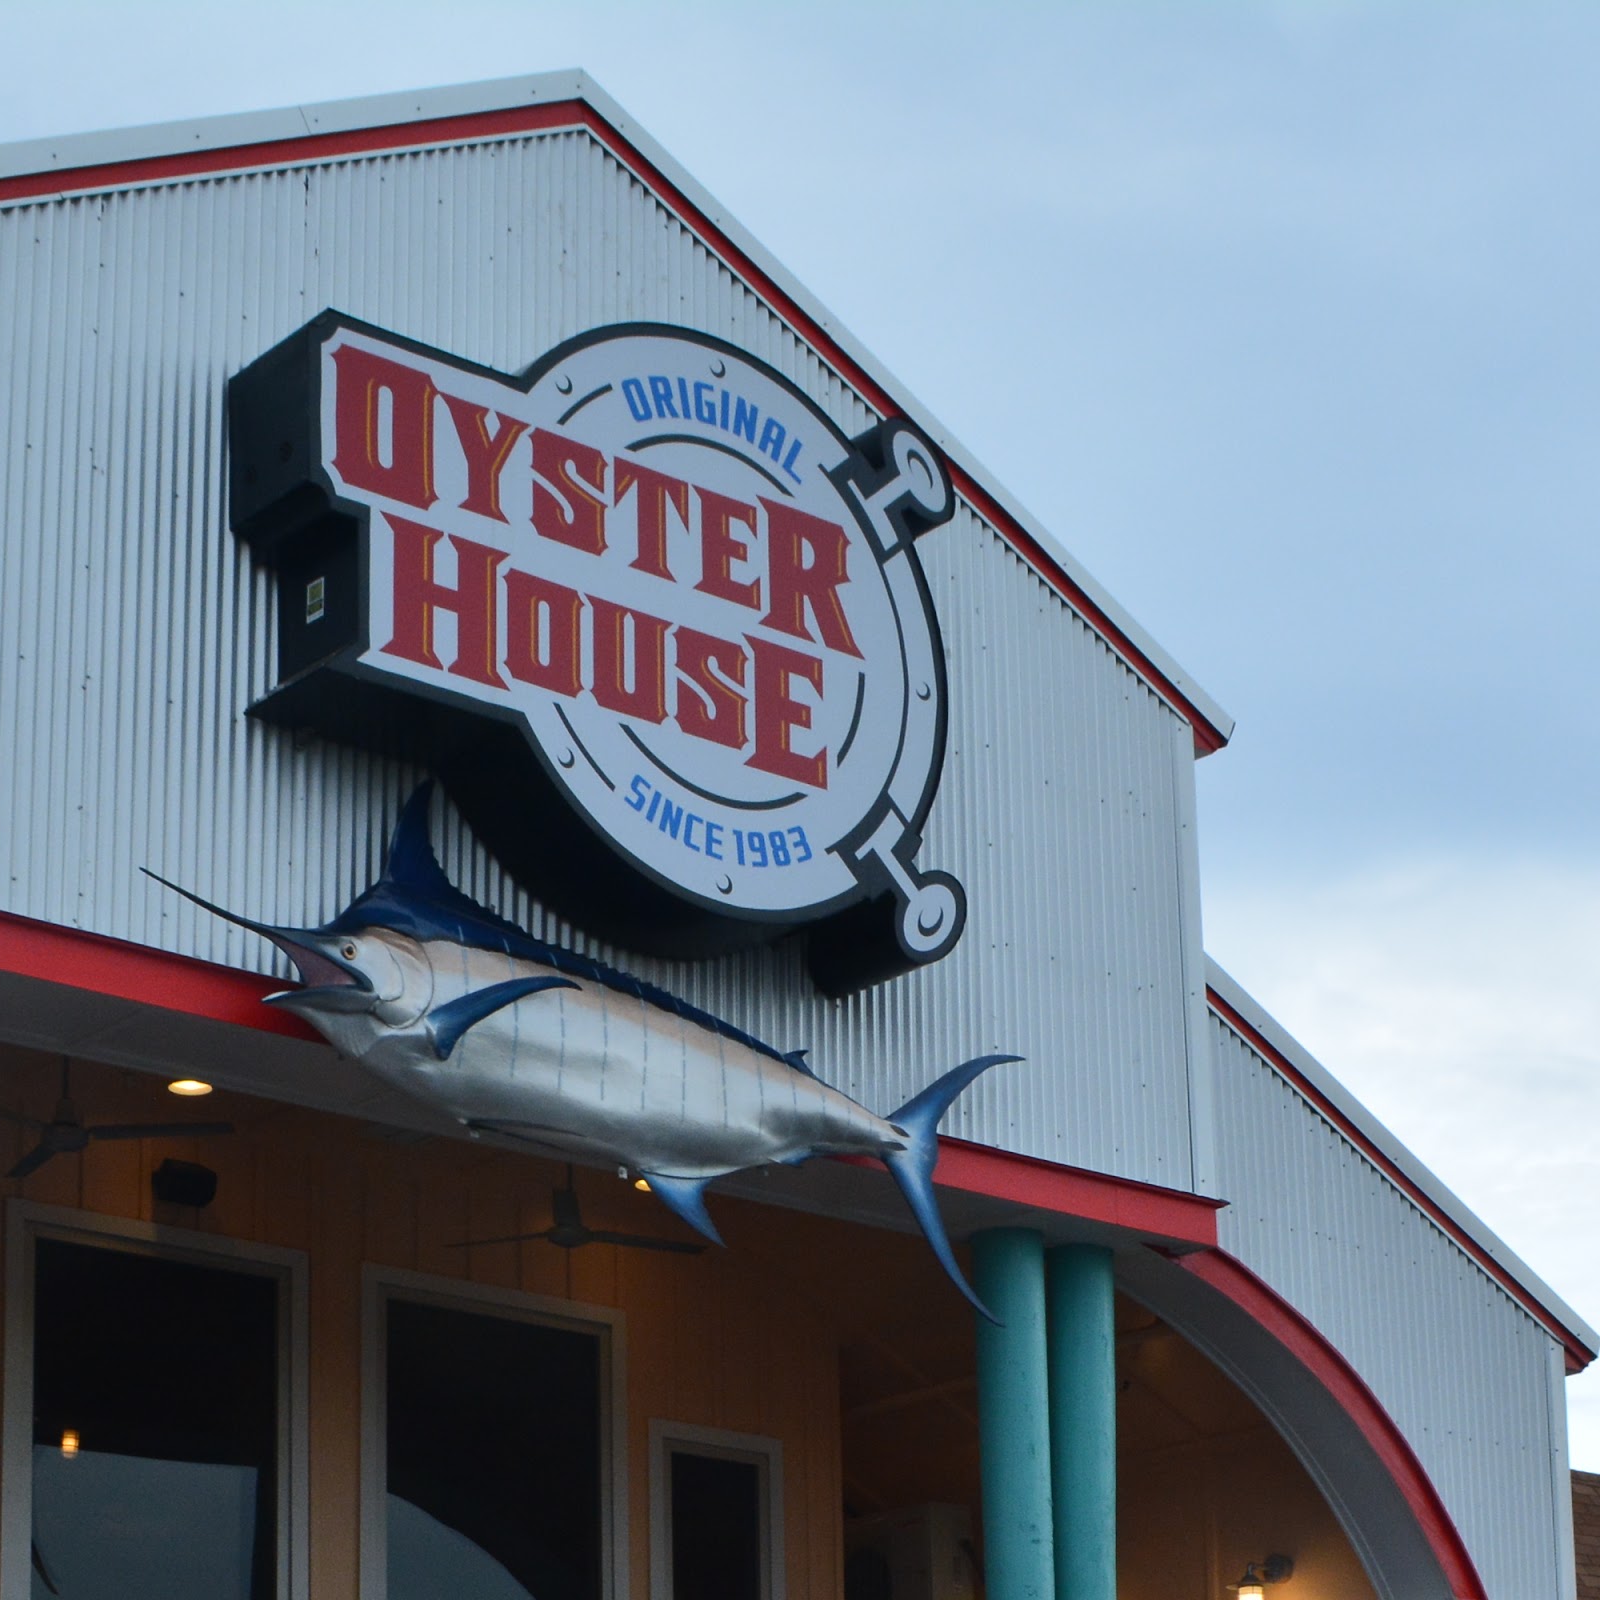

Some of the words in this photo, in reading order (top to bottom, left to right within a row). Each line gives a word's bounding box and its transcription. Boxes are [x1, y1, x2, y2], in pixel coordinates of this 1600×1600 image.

[329, 342, 866, 661] OYSTER
[620, 375, 803, 485] ORIGINAL
[379, 510, 828, 791] HOUSE
[623, 773, 725, 864] SINCE
[731, 824, 812, 869] 1983
